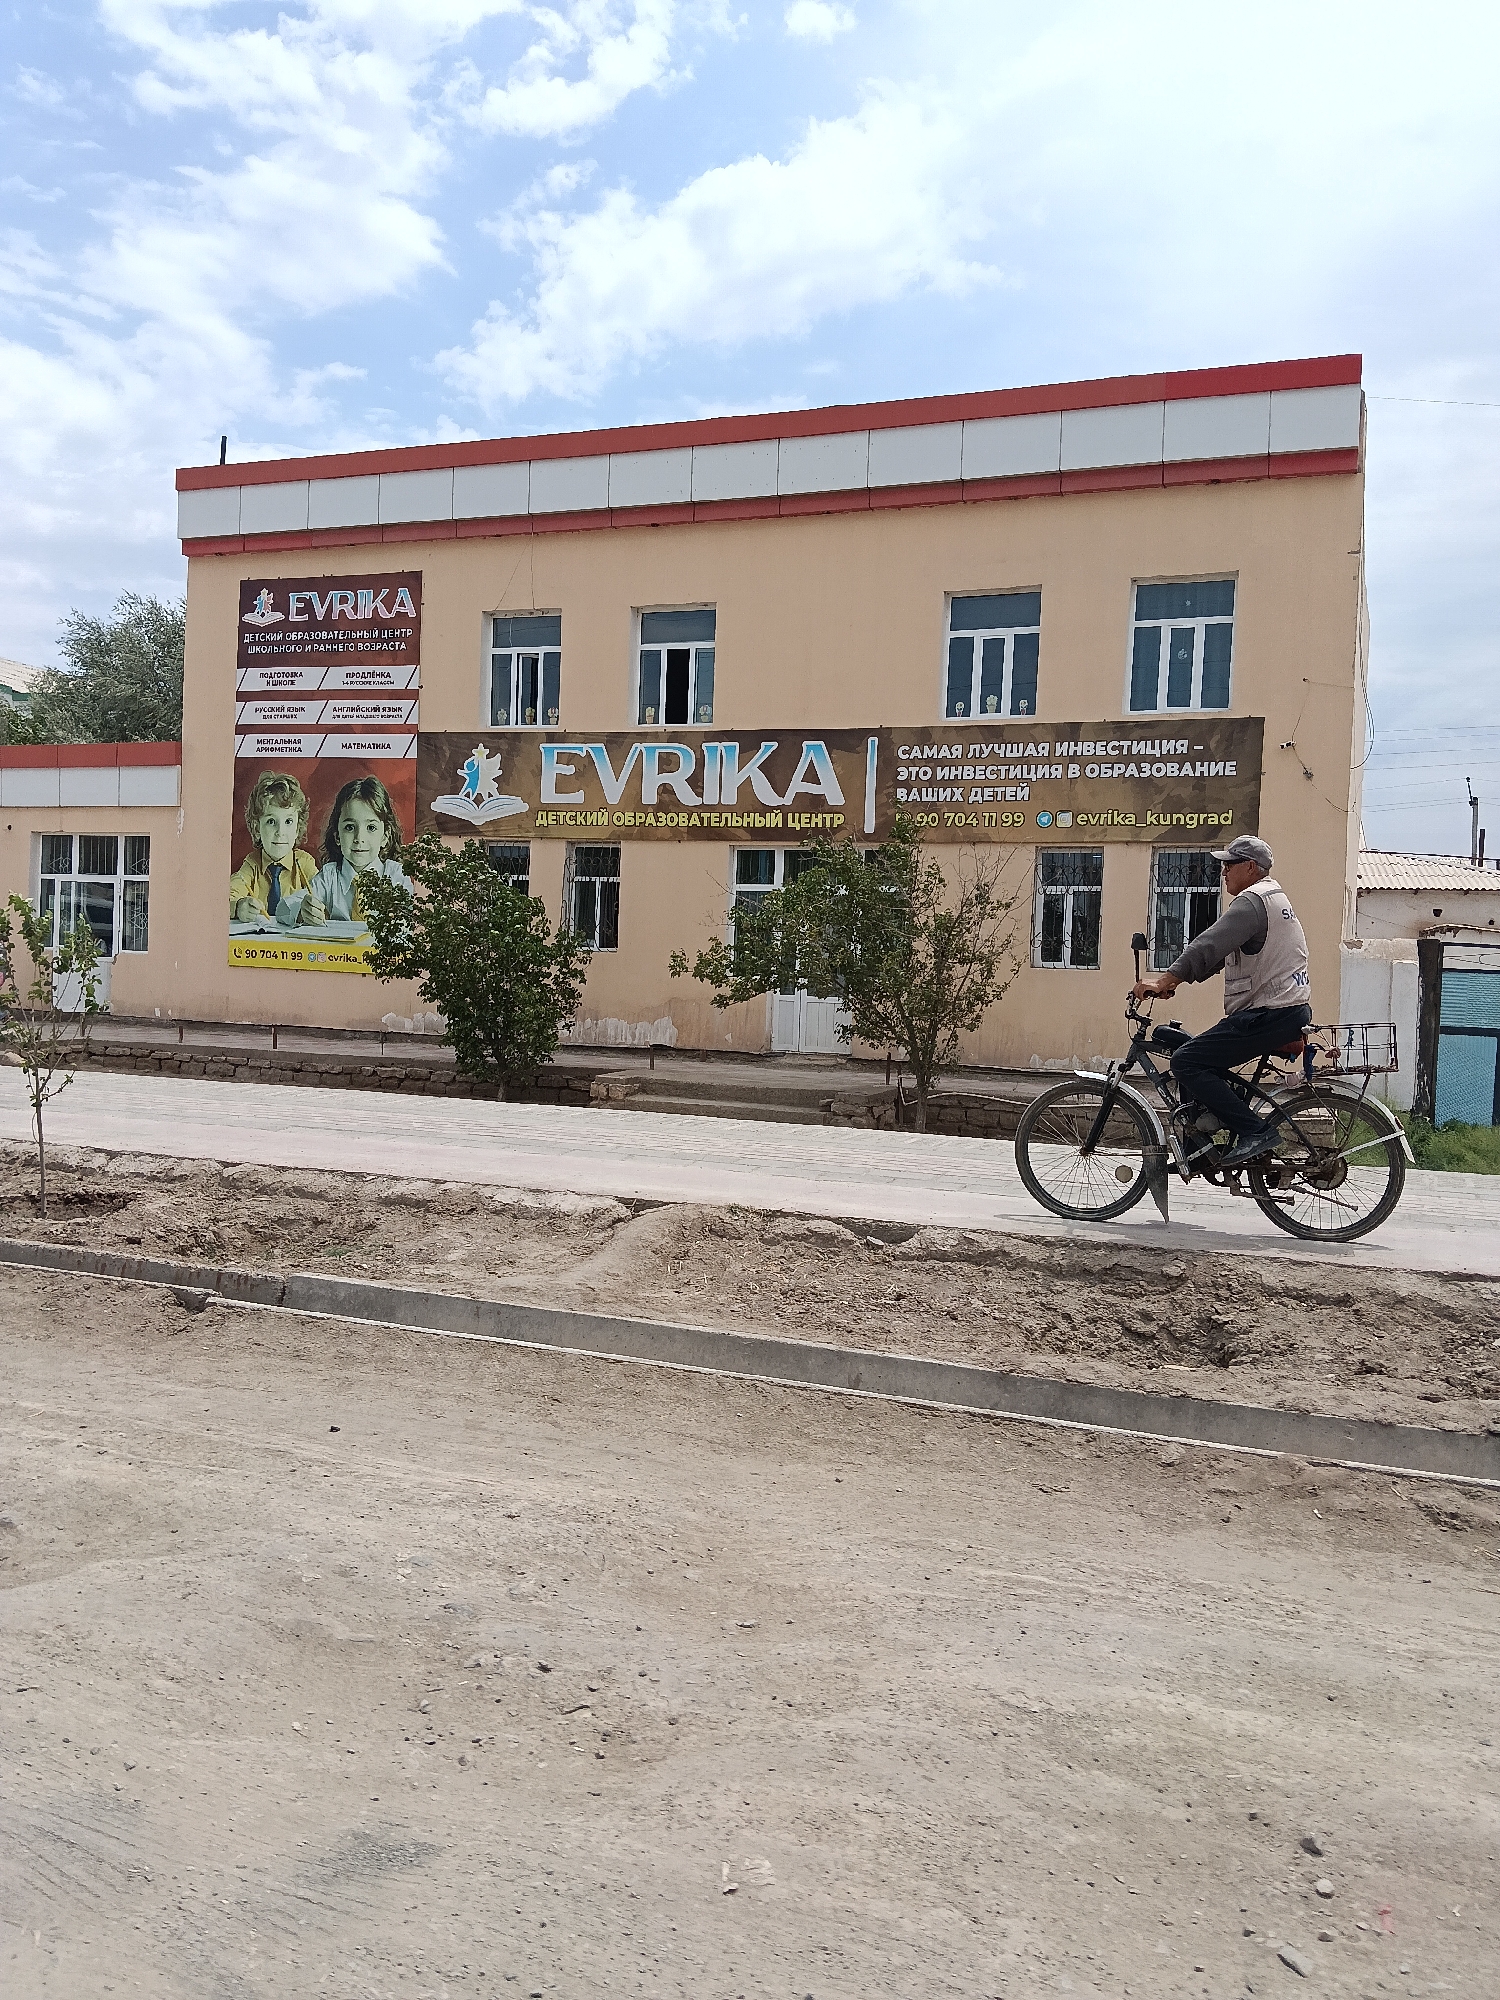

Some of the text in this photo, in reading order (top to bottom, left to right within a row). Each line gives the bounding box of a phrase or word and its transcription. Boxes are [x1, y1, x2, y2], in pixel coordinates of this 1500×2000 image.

[289, 588, 416, 621] EVRIKA
[243, 627, 413, 644] ДЕТСКИЙ ОБРАЗОВАТЕЛЬНЫЙ ЦЕНТР
[247, 641, 407, 654] ШКОЛЬНОГО И РАННЕГО ВОЗРАСТА
[259, 671, 304, 679] ПОДГОТОВКА
[345, 670, 392, 679] ПРОДЛЁНКА
[254, 705, 285, 713] РУССКИЙ
[332, 705, 381, 713] АНГЛИЙСКИЙ
[256, 738, 302, 746] МЕНТАЛЬНАЯ
[341, 742, 392, 750] МАТЕМАТИКА
[897, 744, 963, 759] САМАЯ
[967, 742, 1050, 758] ЛУЧШАЯ
[1055, 739, 1189, 757] ИНВЕСТИЦИЯ
[539, 740, 846, 807] EVRIKA
[896, 761, 1237, 782] ЭТО ИНВЕСТИЦИЯ В ОБРАЗОВАНИЕ
[896, 782, 1030, 804] ВАШИХ ДЕТЕЙ
[535, 807, 845, 830] ДЕТСКИЙ ОБРАЗОВАТЕЛЬНЫЙ ЦЕНТР
[916, 812, 1025, 827] 90 704 11 99
[1076, 809, 1233, 829] evrika_kungrad
[245, 949, 303, 961] 90 704 11 99
